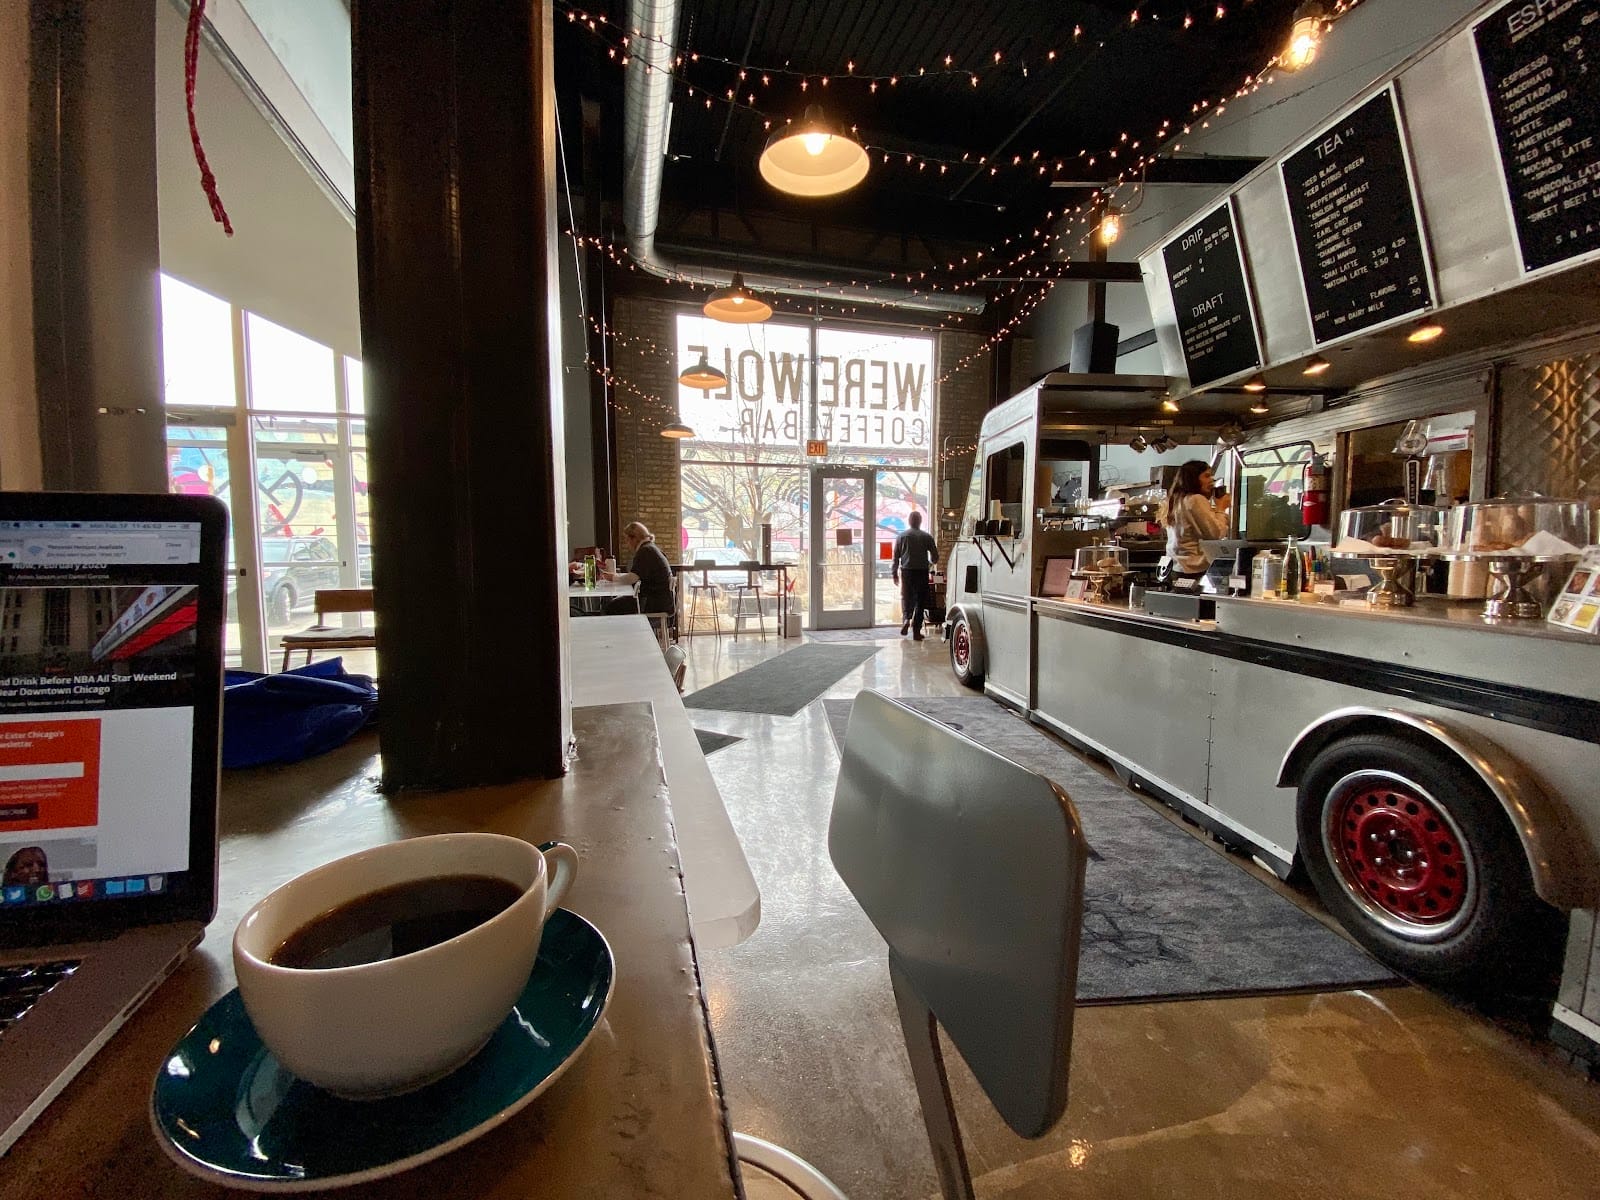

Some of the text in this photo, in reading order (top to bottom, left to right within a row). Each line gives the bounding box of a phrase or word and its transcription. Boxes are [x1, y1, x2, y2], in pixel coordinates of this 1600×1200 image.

[1502, 54, 1547, 88] ESPRESSO
[1505, 48, 1584, 100] MACCHIATO 2
[1509, 83, 1551, 112] CORTADO
[1513, 89, 1568, 125] CAPPUCCINO
[1515, 116, 1544, 138] LATTE
[1518, 117, 1573, 151] AMERICANO
[1314, 134, 1343, 159] TEA
[1519, 135, 1564, 164] RED EYE
[1522, 136, 1593, 176] MOCHA LATTE
[1304, 162, 1337, 188] ICED BLACK
[1306, 156, 1365, 197] ICED CITRUS GREEN
[1528, 174, 1573, 200] CHARCOAL
[1309, 182, 1347, 210] PEPPERMINT
[1312, 181, 1369, 220] ENGLISH BREAKFAST
[1542, 177, 1588, 203] MAY ALTER
[1313, 197, 1364, 229] TURMERIC GINGER
[1530, 204, 1558, 222] SWEET
[1563, 192, 1588, 209] BEET
[1182, 228, 1203, 251] DRIP
[1316, 216, 1349, 239] EARL GREY
[1317, 220, 1363, 249] JASMINE GREEN
[1320, 237, 1351, 258] CHAMOMILE
[1336, 245, 1357, 260] MANGO
[1325, 275, 1348, 289] MATCHA
[1349, 265, 1369, 279] LATTE
[1340, 258, 1359, 273] LATTE
[1370, 284, 1397, 299] FLAVORS
[1192, 293, 1223, 318] DRAFT
[1348, 308, 1365, 320] DAIRY
[1367, 301, 1385, 313] MILK
[809, 441, 825, 454] EXIT
[19, 686, 71, 696] Downtown
[73, 685, 110, 696] Chicago
[40, 676, 71, 685] Before
[73, 675, 94, 684] NBA
[97, 674, 109, 683] All
[111, 674, 132, 682] Star
[133, 672, 177, 682] Weekend
